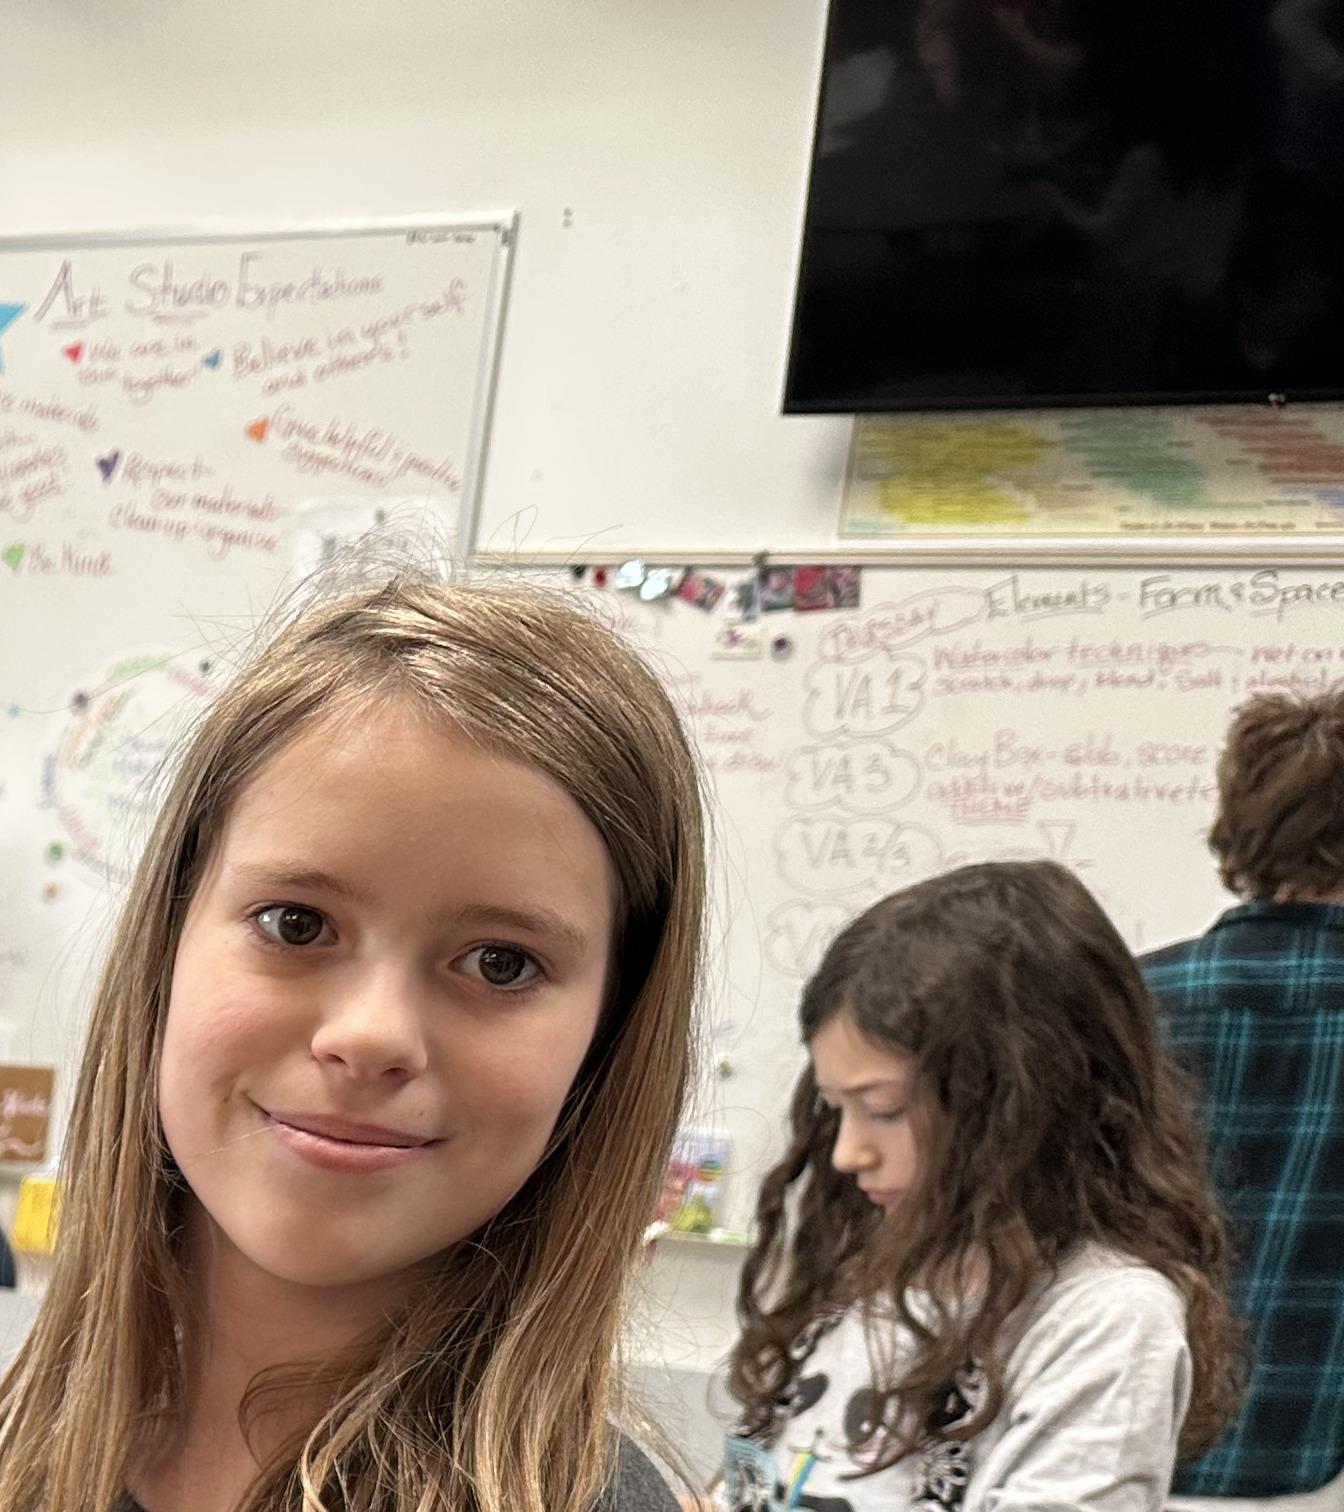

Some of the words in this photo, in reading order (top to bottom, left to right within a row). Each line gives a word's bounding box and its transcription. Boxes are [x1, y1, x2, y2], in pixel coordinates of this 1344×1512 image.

[33, 259, 110, 324] Art
[124, 257, 230, 318] Studio
[985, 575, 1111, 622] Elements
[811, 754, 856, 794] VA
